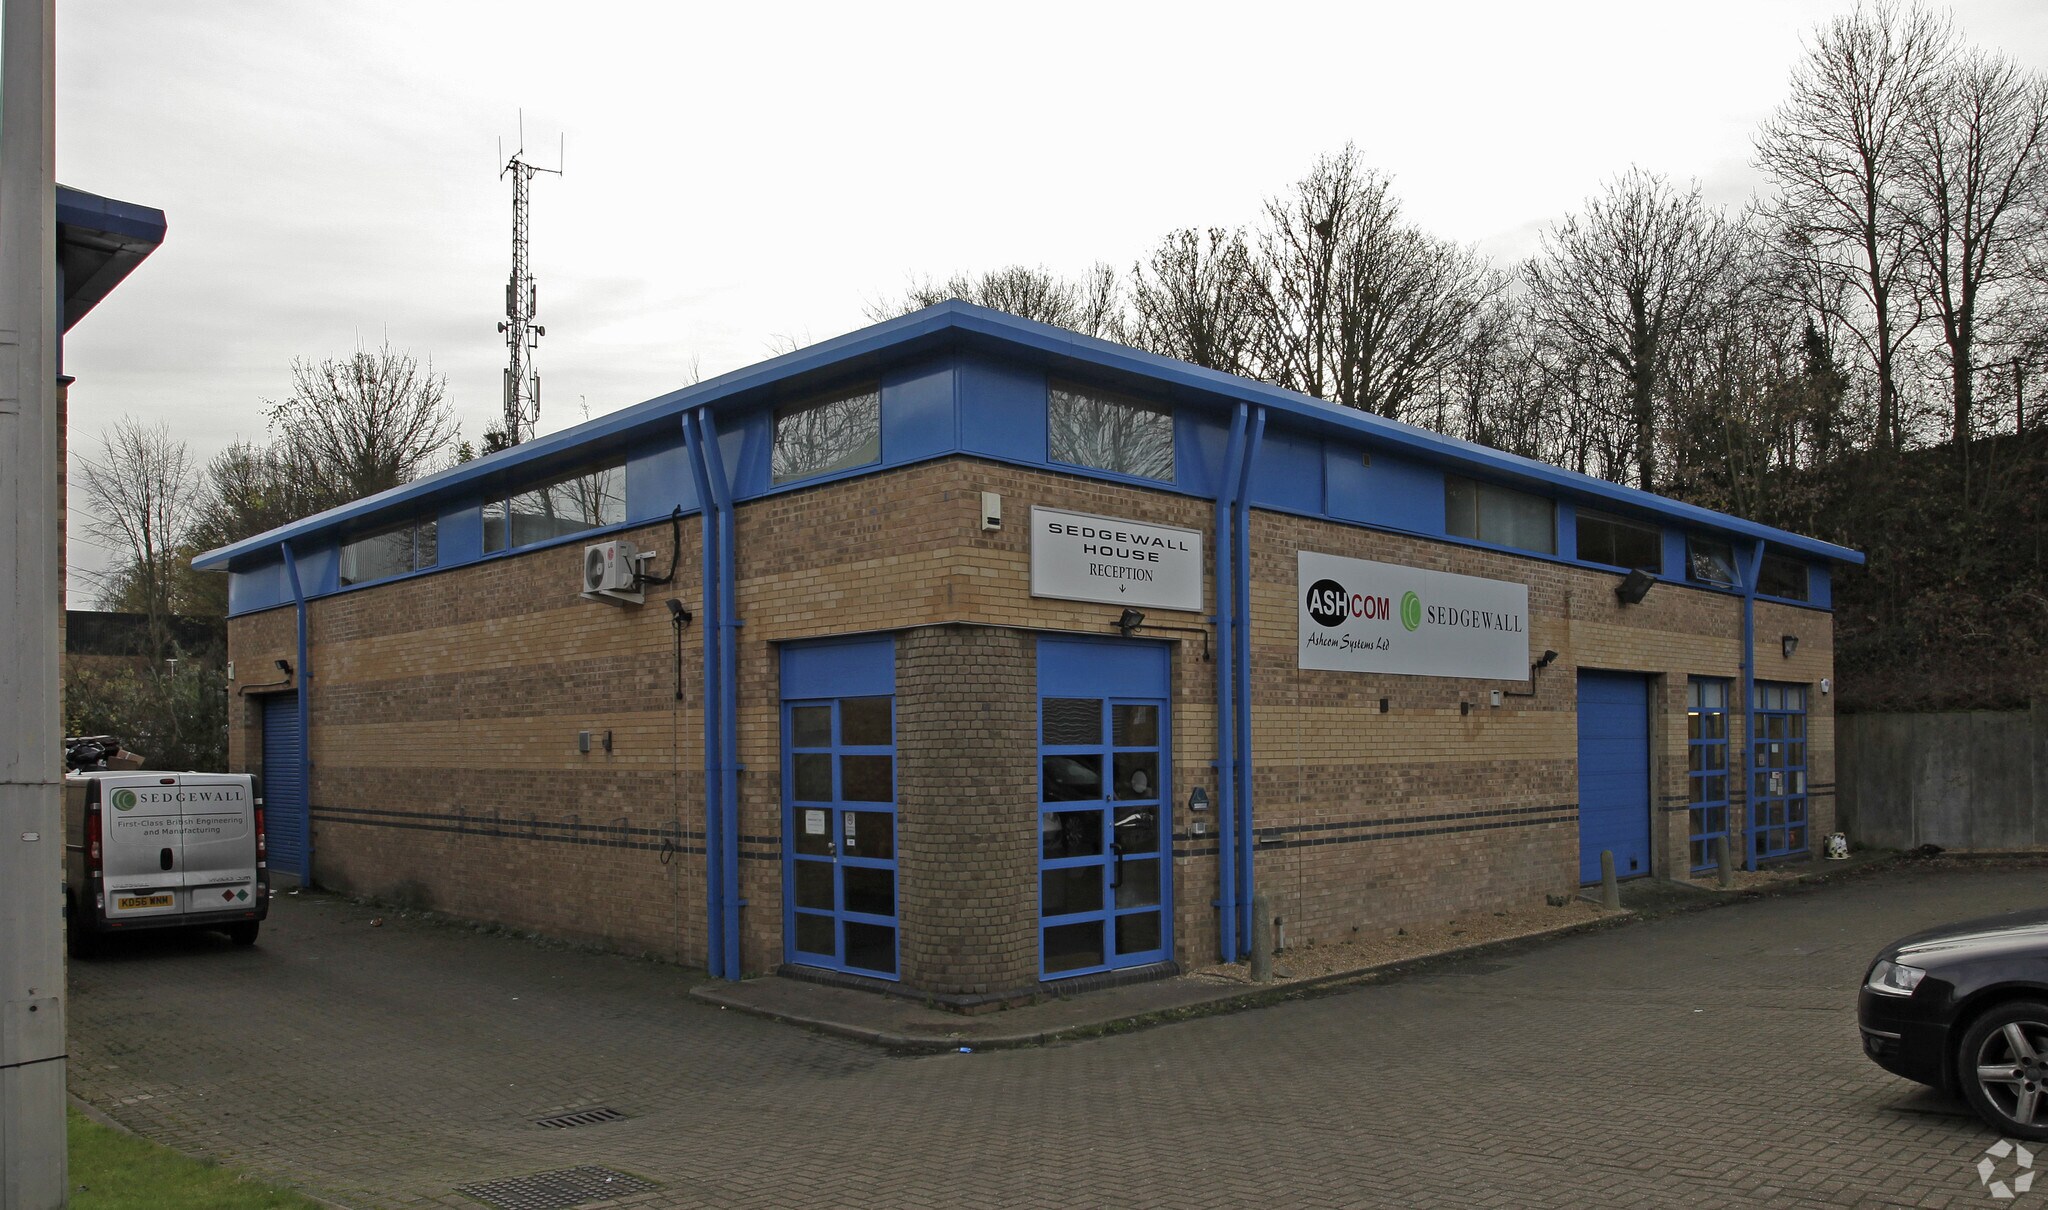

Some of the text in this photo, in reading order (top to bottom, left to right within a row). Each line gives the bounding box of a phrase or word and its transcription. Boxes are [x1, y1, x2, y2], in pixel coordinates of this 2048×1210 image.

[1048, 523, 1189, 552] SEDGEWALL
[1083, 543, 1160, 563] HOUSE
[607, 561, 614, 569] LG
[1089, 562, 1154, 582] RECEPTION
[1309, 588, 1390, 621] ASHCOM
[1427, 604, 1523, 633] SEDGEWALL
[1306, 632, 1390, 653] Ashcom Systems Ltd
[140, 791, 243, 803] SEDGEWALL
[118, 820, 164, 828] First-Class
[196, 817, 243, 826] Engineering
[162, 826, 221, 835] Manufacturing
[121, 897, 147, 907] KD56
